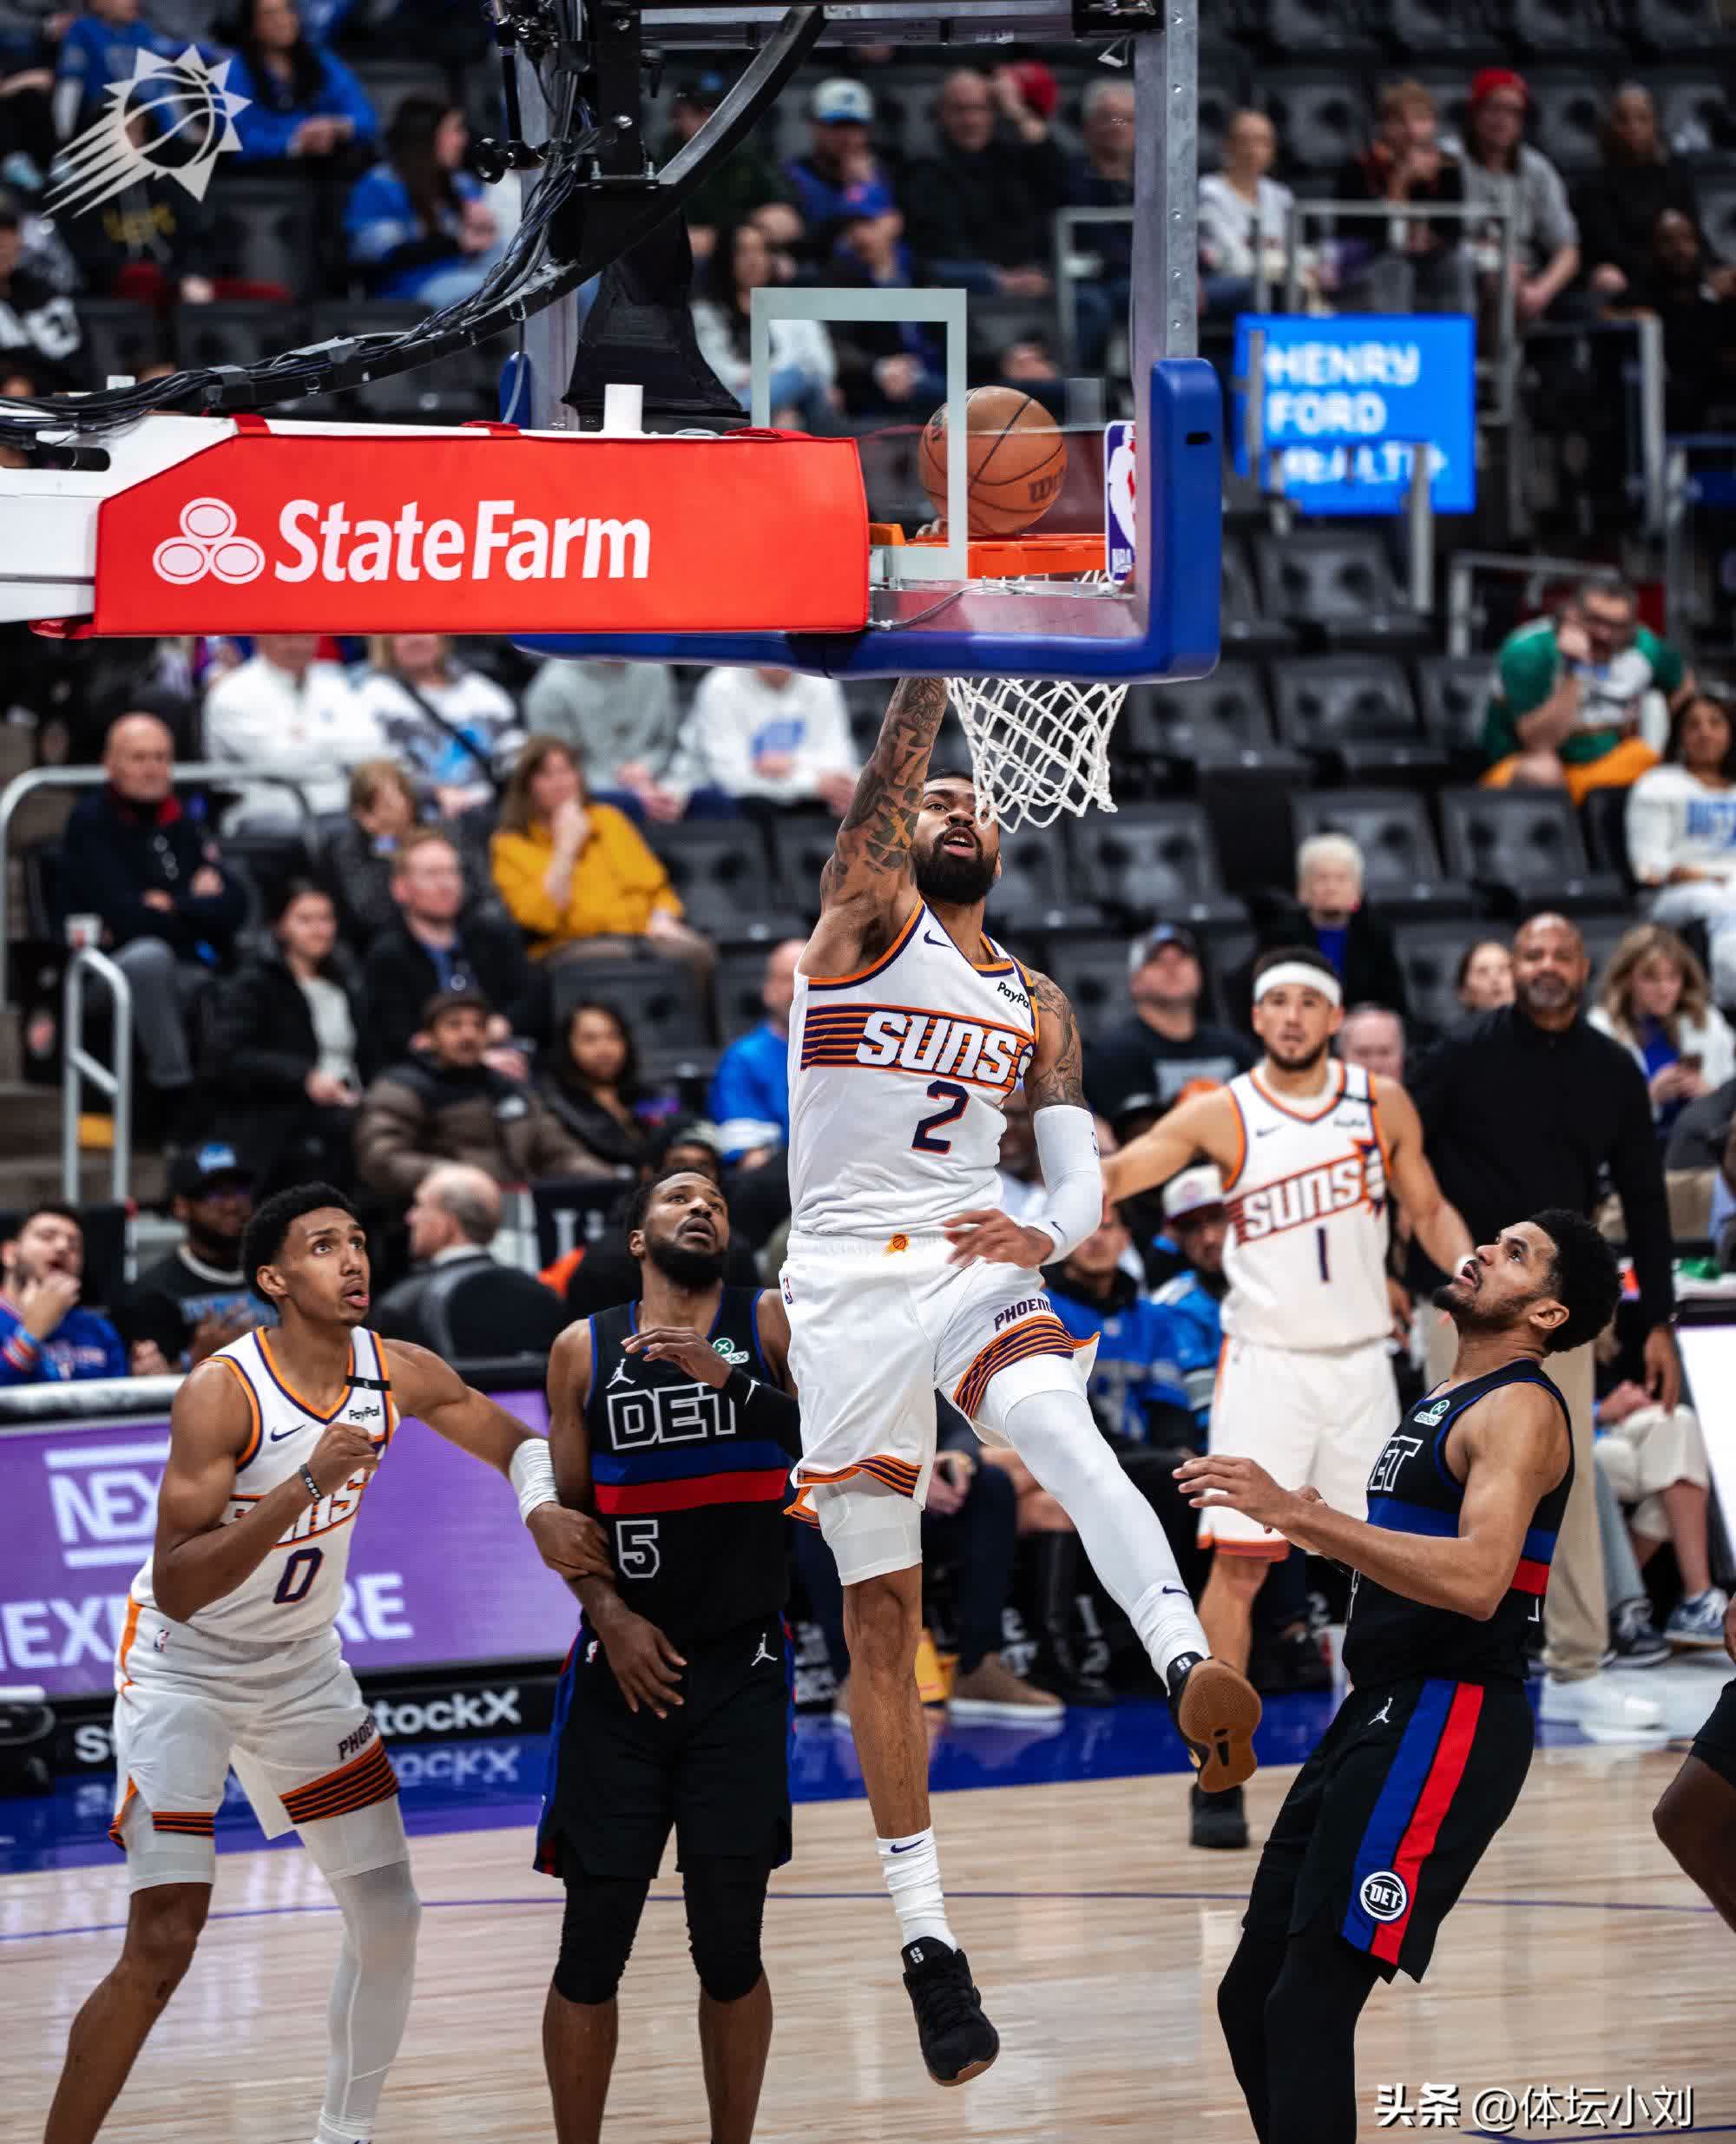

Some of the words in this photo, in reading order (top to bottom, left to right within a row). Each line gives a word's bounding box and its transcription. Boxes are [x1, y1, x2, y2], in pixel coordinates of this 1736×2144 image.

[1266, 391, 1387, 436] FORD
[856, 1011, 1016, 1084] SUNS
[911, 1080, 970, 1154] 2
[1243, 1159, 1361, 1239] SUNS
[1316, 1227, 1329, 1282] 1
[349, 1405, 380, 1422] PayPal
[273, 1548, 325, 1603] 0
[616, 1519, 660, 1578] 5
[374, 1687, 521, 1736] tockX
[1370, 1883, 1400, 1909] DET
